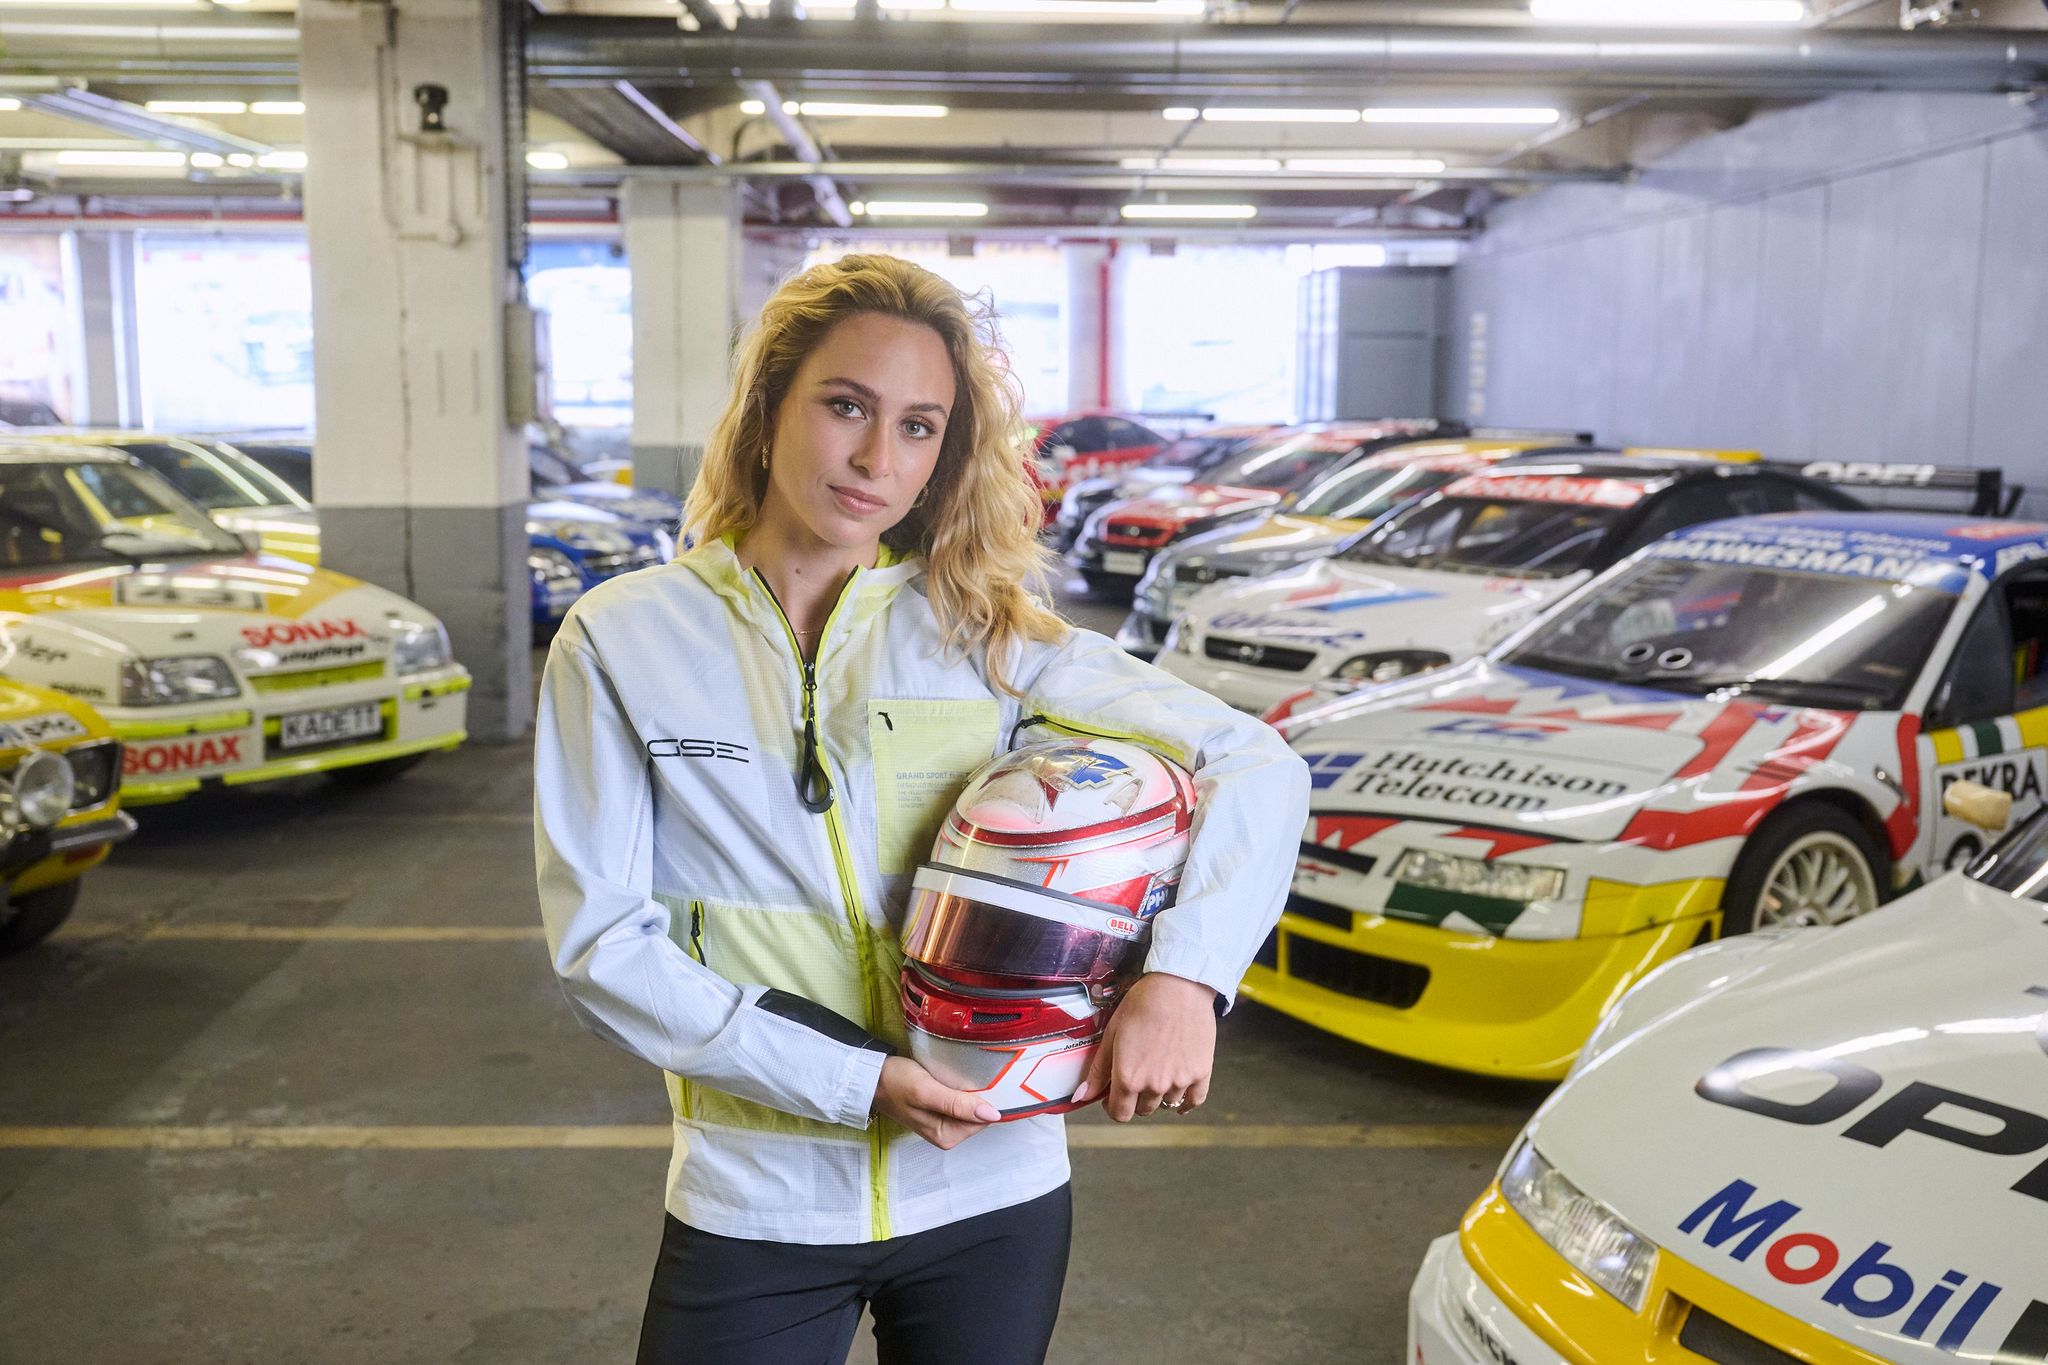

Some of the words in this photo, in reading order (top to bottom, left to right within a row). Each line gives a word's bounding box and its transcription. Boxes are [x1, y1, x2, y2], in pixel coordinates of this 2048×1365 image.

[1653, 540, 1955, 584] MANNESMAN
[240, 618, 367, 648] SONAX
[122, 736, 241, 774] SONAX
[646, 738, 750, 763] GSE
[896, 771, 924, 780] GRAND
[926, 771, 947, 780] SPORT
[1350, 770, 1548, 812] Telecom
[1374, 750, 1628, 797] Hutchison
[1110, 919, 1136, 933] BELL
[1677, 1178, 2003, 1355] Mobil
